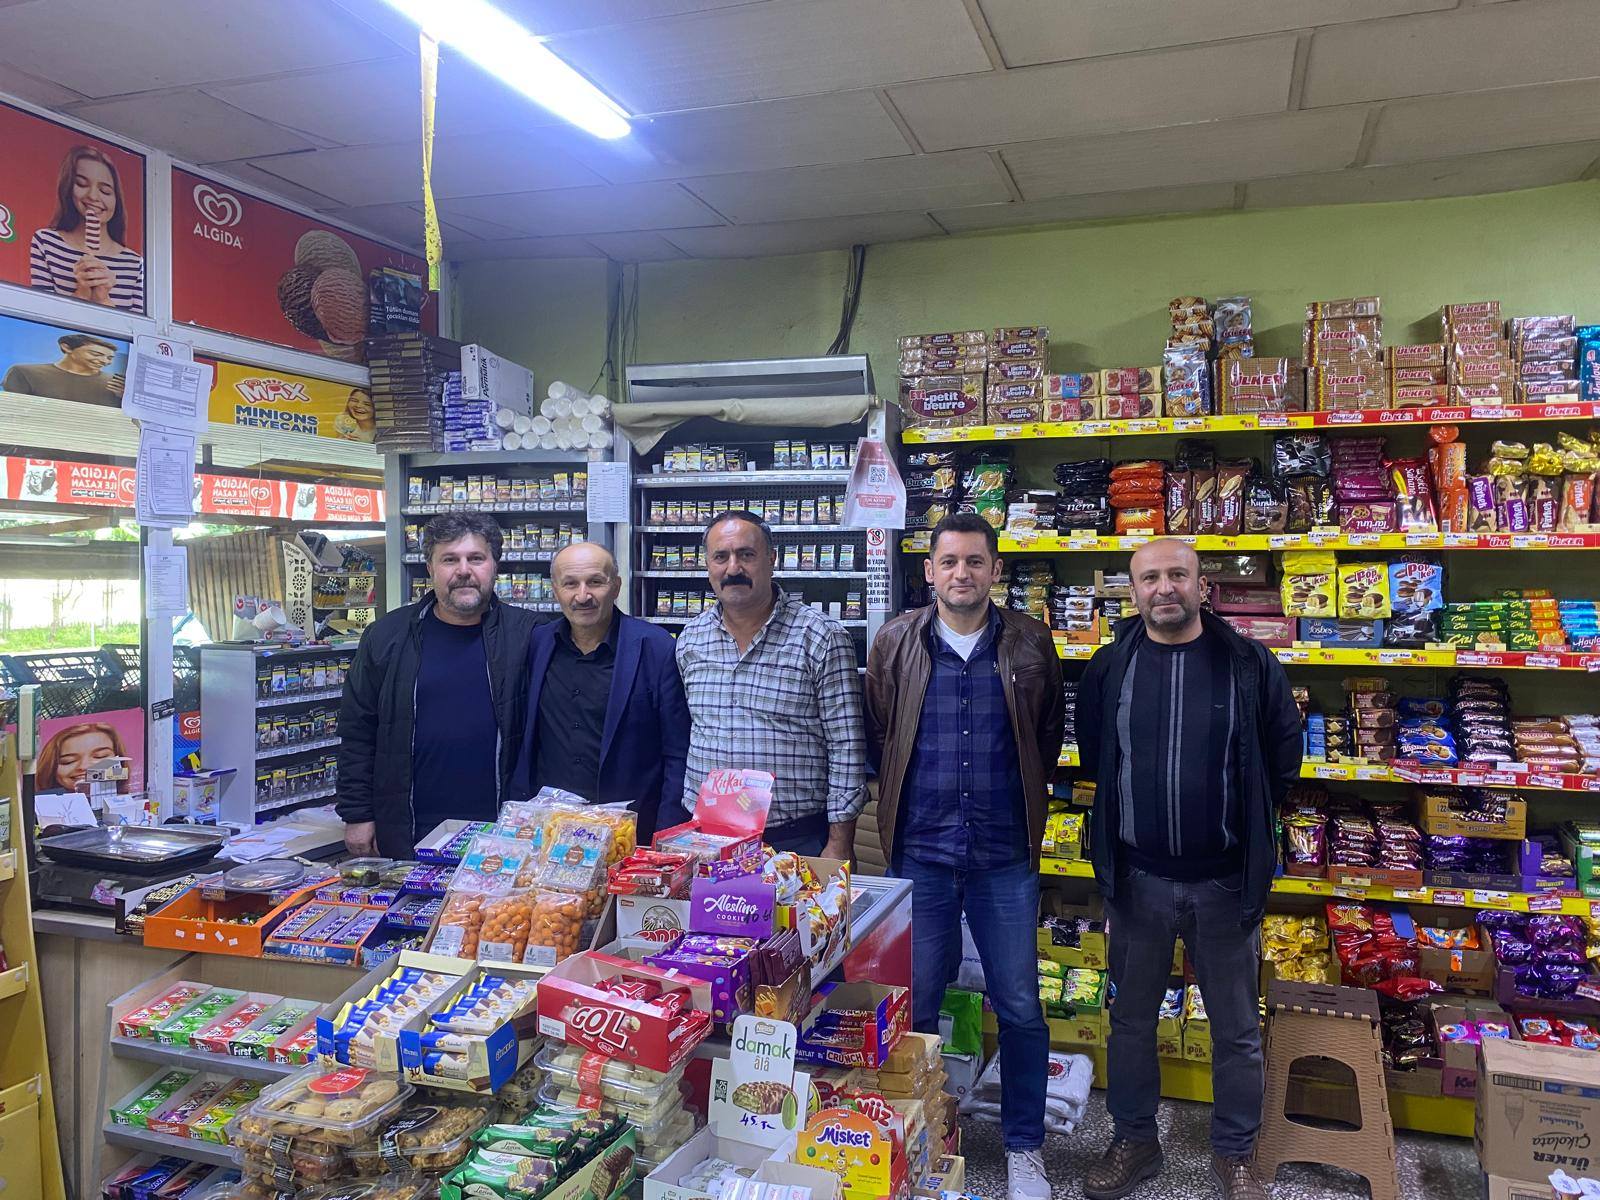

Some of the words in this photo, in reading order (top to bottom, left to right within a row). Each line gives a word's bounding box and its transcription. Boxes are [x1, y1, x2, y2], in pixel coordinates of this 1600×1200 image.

[1465, 362, 1500, 371] ÜLKER
[1230, 372, 1285, 387] ÜLKER
[1327, 375, 1366, 385] ÜLKER
[235, 379, 311, 404] MAX
[928, 391, 958, 402] petit
[1397, 389, 1431, 397] ÜLKER
[923, 401, 965, 411] beurre
[1544, 406, 1581, 416] ÜLKER
[236, 404, 318, 425] MINIONS
[1431, 410, 1465, 420] ÜLKER
[236, 416, 318, 435] HEYECANI
[1067, 502, 1094, 511] nero
[1548, 536, 1584, 545] ÜLKER
[1407, 562, 1430, 576] Pop
[1356, 569, 1377, 582] Pop
[703, 894, 758, 915] Alestino
[571, 1006, 628, 1049] GOL
[735, 1027, 791, 1060] damak
[234, 1047, 251, 1056] First
[827, 1051, 863, 1063] CRUNCH
[275, 1054, 290, 1063] First
[817, 1125, 871, 1148] Misket
[1532, 1132, 1591, 1151] Çikolata
[1533, 1151, 1590, 1171] ÜLKER
